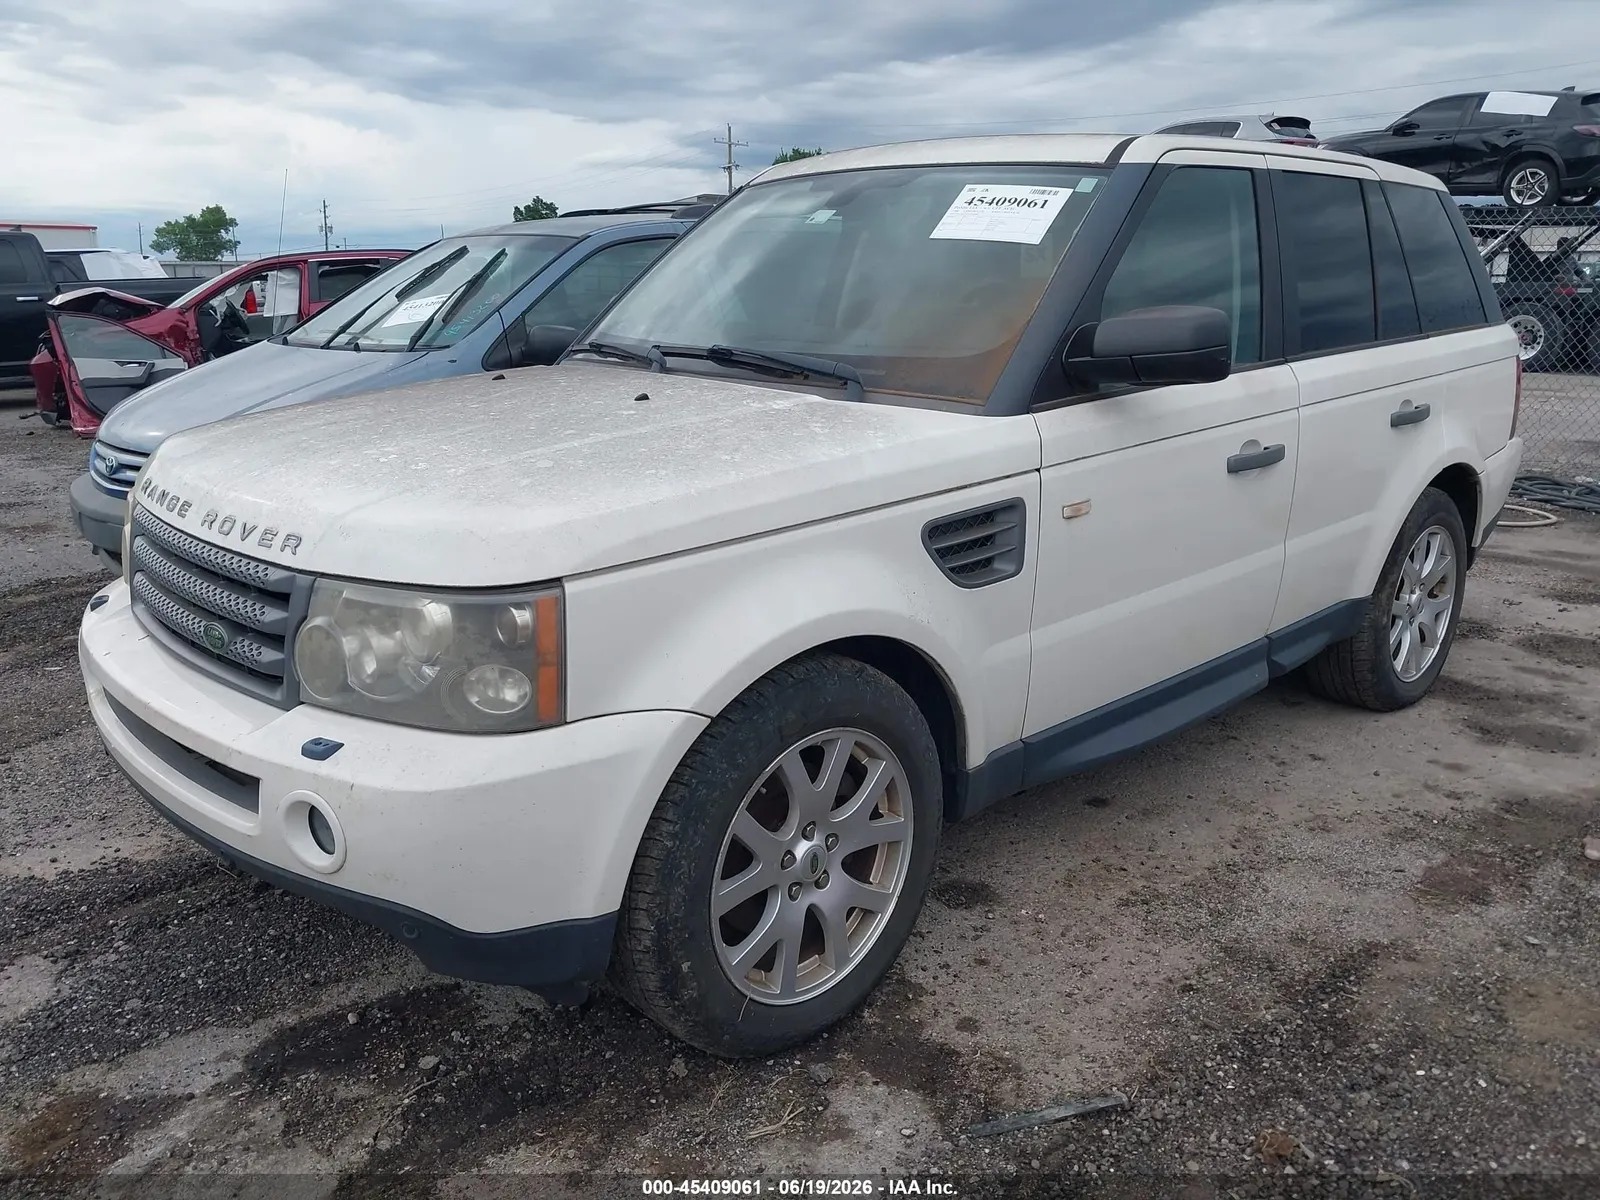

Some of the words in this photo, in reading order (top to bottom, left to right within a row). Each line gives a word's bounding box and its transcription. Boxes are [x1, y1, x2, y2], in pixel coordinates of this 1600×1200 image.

[964, 195, 1049, 210] 45409061
[140, 478, 193, 519] RANGE
[201, 509, 302, 556] ROVER
